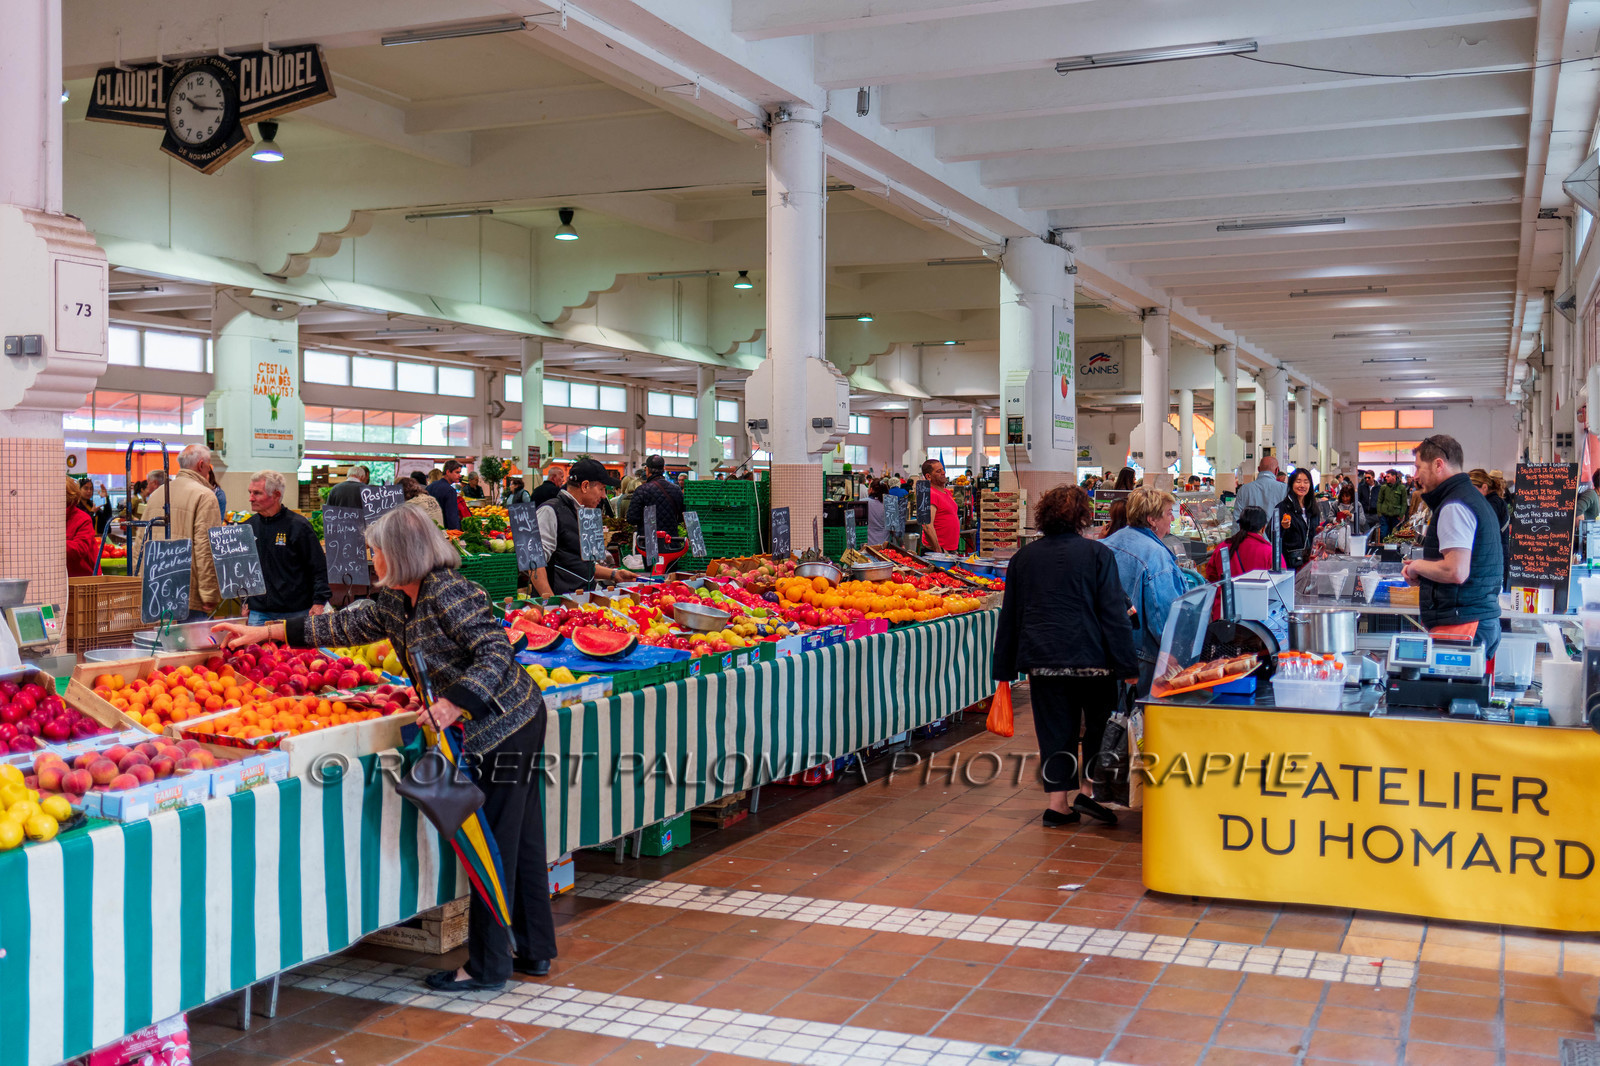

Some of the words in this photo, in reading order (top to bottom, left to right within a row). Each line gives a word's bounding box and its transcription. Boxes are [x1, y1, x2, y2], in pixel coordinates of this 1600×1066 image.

[196, 76, 205, 86] 12
[240, 51, 317, 102] CLAUDEL
[97, 69, 166, 109] CLAUDEL
[186, 81, 194, 91] 11
[209, 79, 213, 89] 1
[178, 91, 187, 101] 10
[215, 88, 222, 98] 2
[175, 106, 182, 116] 9
[178, 118, 185, 128] 8
[214, 115, 220, 124] 4
[186, 128, 192, 138] 7
[196, 130, 203, 140] 6
[207, 126, 214, 136] 5
[188, 141, 229, 161] NORMANDIE
[75, 302, 92, 318] 73
[258, 361, 278, 374] C'EST
[279, 365, 289, 376] LA
[1080, 364, 1119, 375] CANNES
[256, 373, 277, 385] FAIM
[278, 375, 291, 387] DES
[241, 765, 265, 780] FAMILY
[1260, 759, 1550, 816] L'ATELIER
[155, 786, 182, 803] FAMILY
[1218, 814, 1296, 856] DU
[1319, 820, 1596, 880] HOMARD
